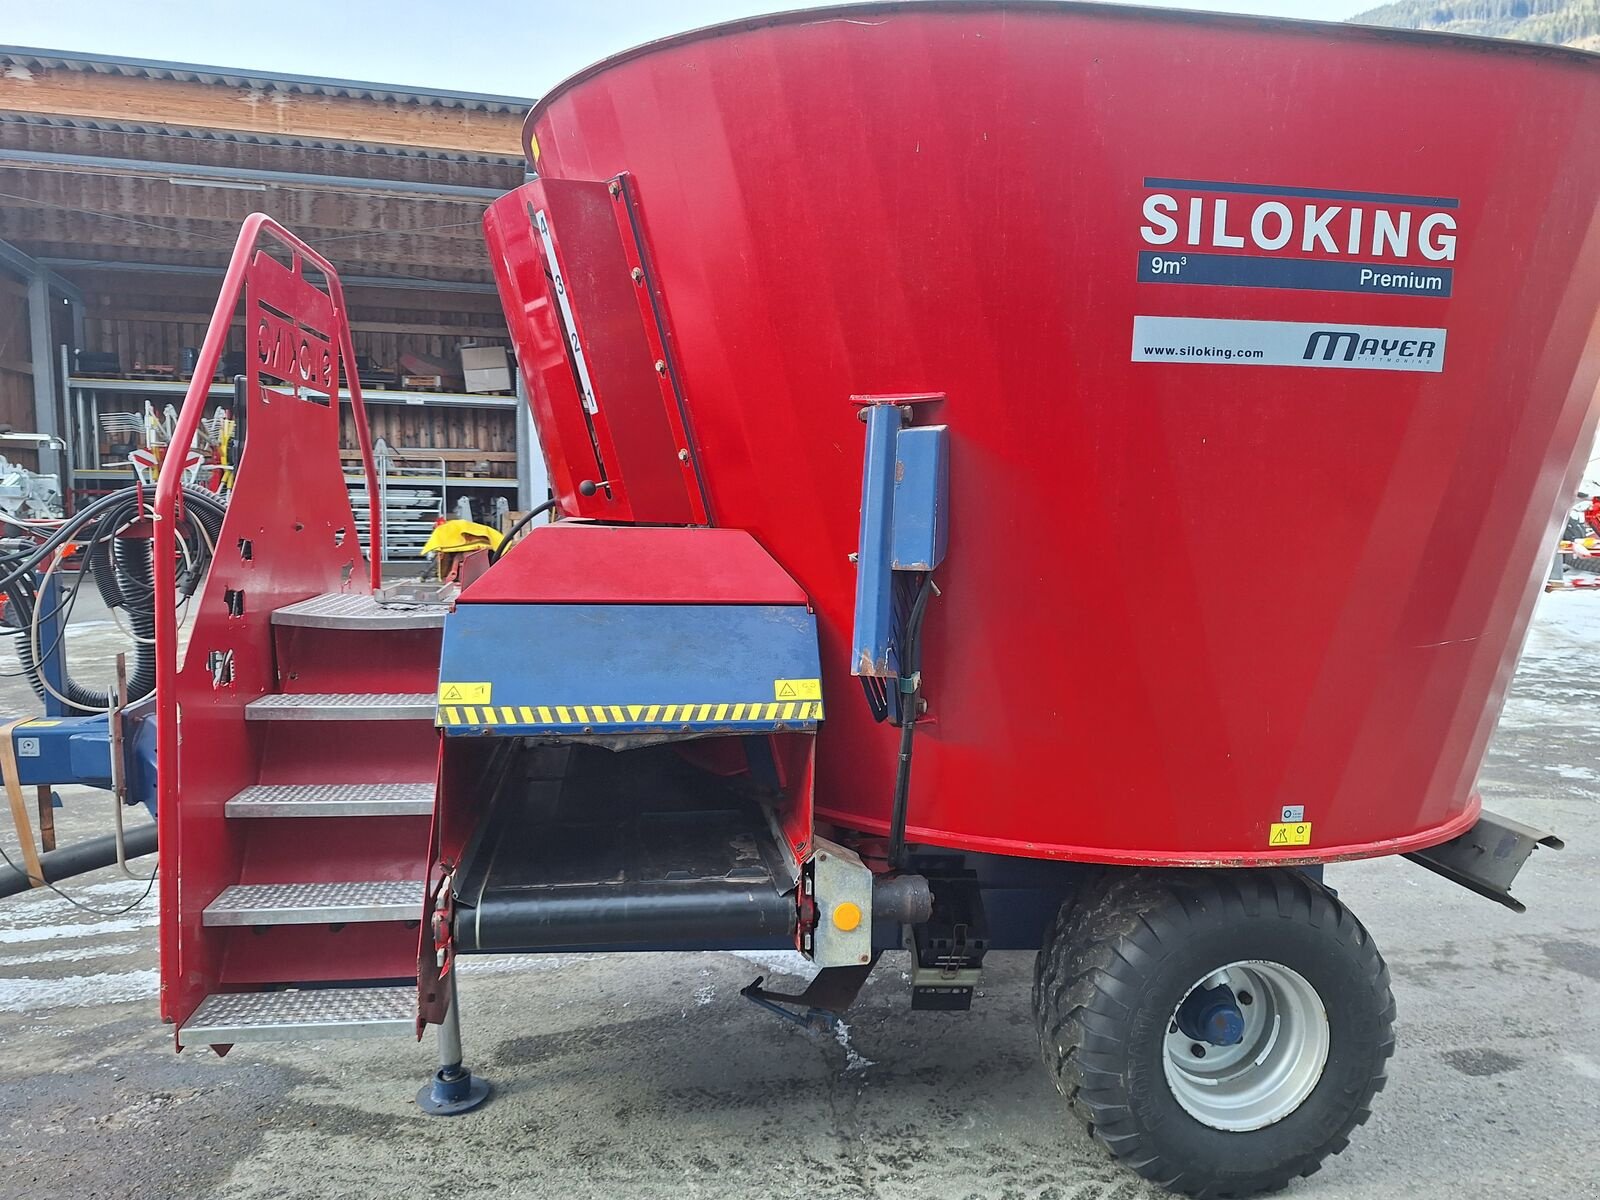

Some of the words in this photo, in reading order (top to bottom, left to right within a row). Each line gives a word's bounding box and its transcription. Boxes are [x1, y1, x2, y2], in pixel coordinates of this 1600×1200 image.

[539, 216, 549, 236] 4
[1140, 194, 1458, 261] SILOKING
[554, 274, 565, 295] 3
[1360, 269, 1442, 290] Premium
[570, 332, 581, 353] 2
[1143, 345, 1264, 360] www.siloking.com
[1302, 331, 1436, 362] MAYER
[587, 389, 595, 408] 1
